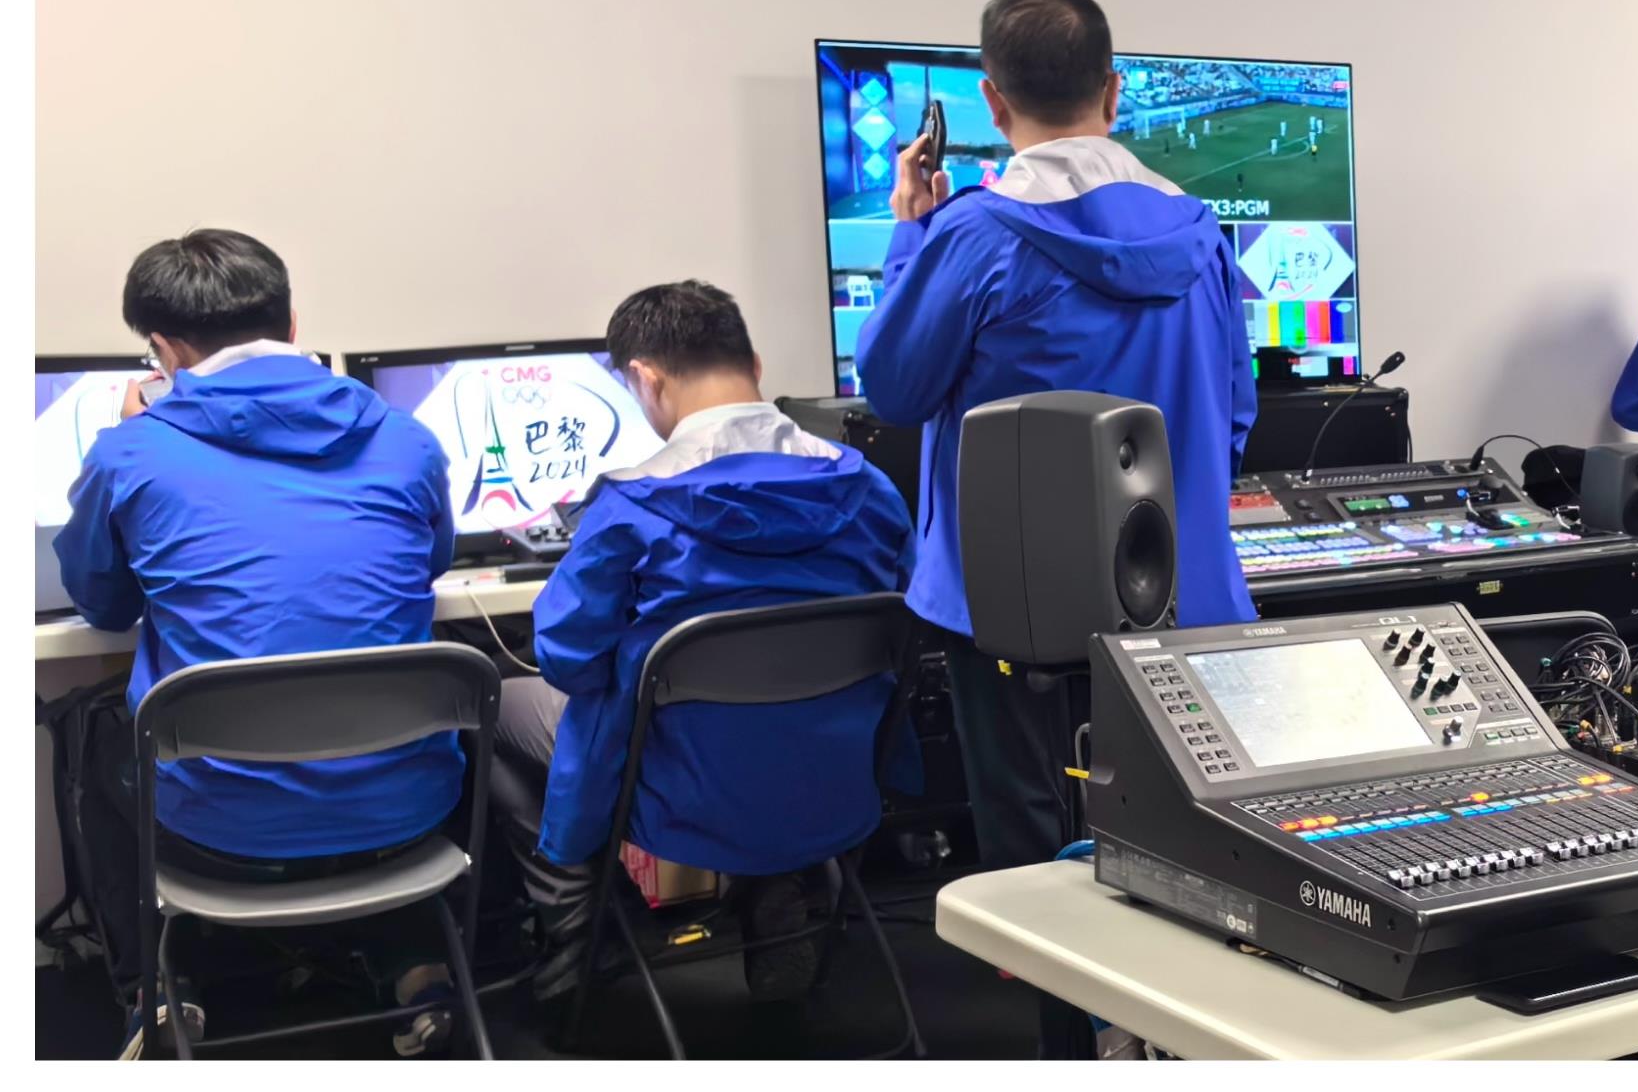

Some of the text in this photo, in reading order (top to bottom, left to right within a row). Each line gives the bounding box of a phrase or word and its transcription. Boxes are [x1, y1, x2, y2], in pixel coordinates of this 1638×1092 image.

[501, 366, 552, 384] CMG
[525, 416, 586, 455] 巴黎
[529, 455, 587, 484] 2024
[1379, 615, 1418, 625] QL1
[1317, 885, 1371, 928] YAMAHA
